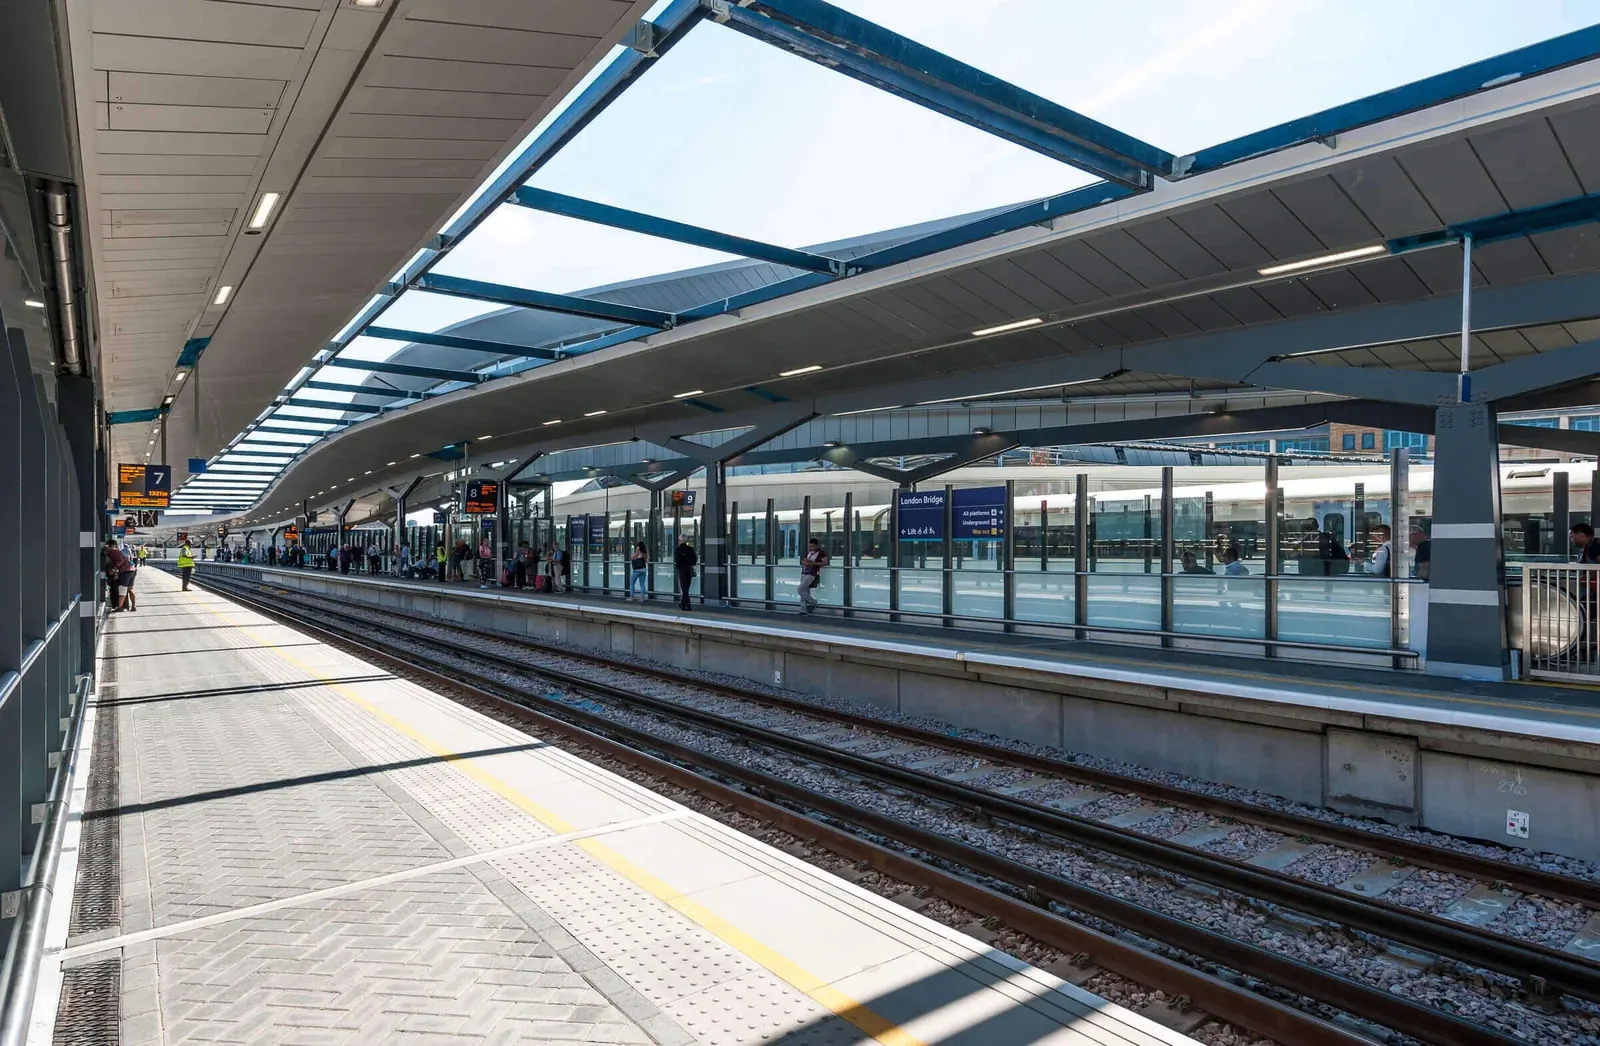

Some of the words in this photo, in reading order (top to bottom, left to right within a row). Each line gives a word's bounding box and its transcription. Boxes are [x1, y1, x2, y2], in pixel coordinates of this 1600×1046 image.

[153, 472, 164, 484] 7
[470, 489, 477, 498] 8
[687, 495, 693, 503] 9
[900, 497, 922, 505] London
[923, 495, 943, 504] Bridge
